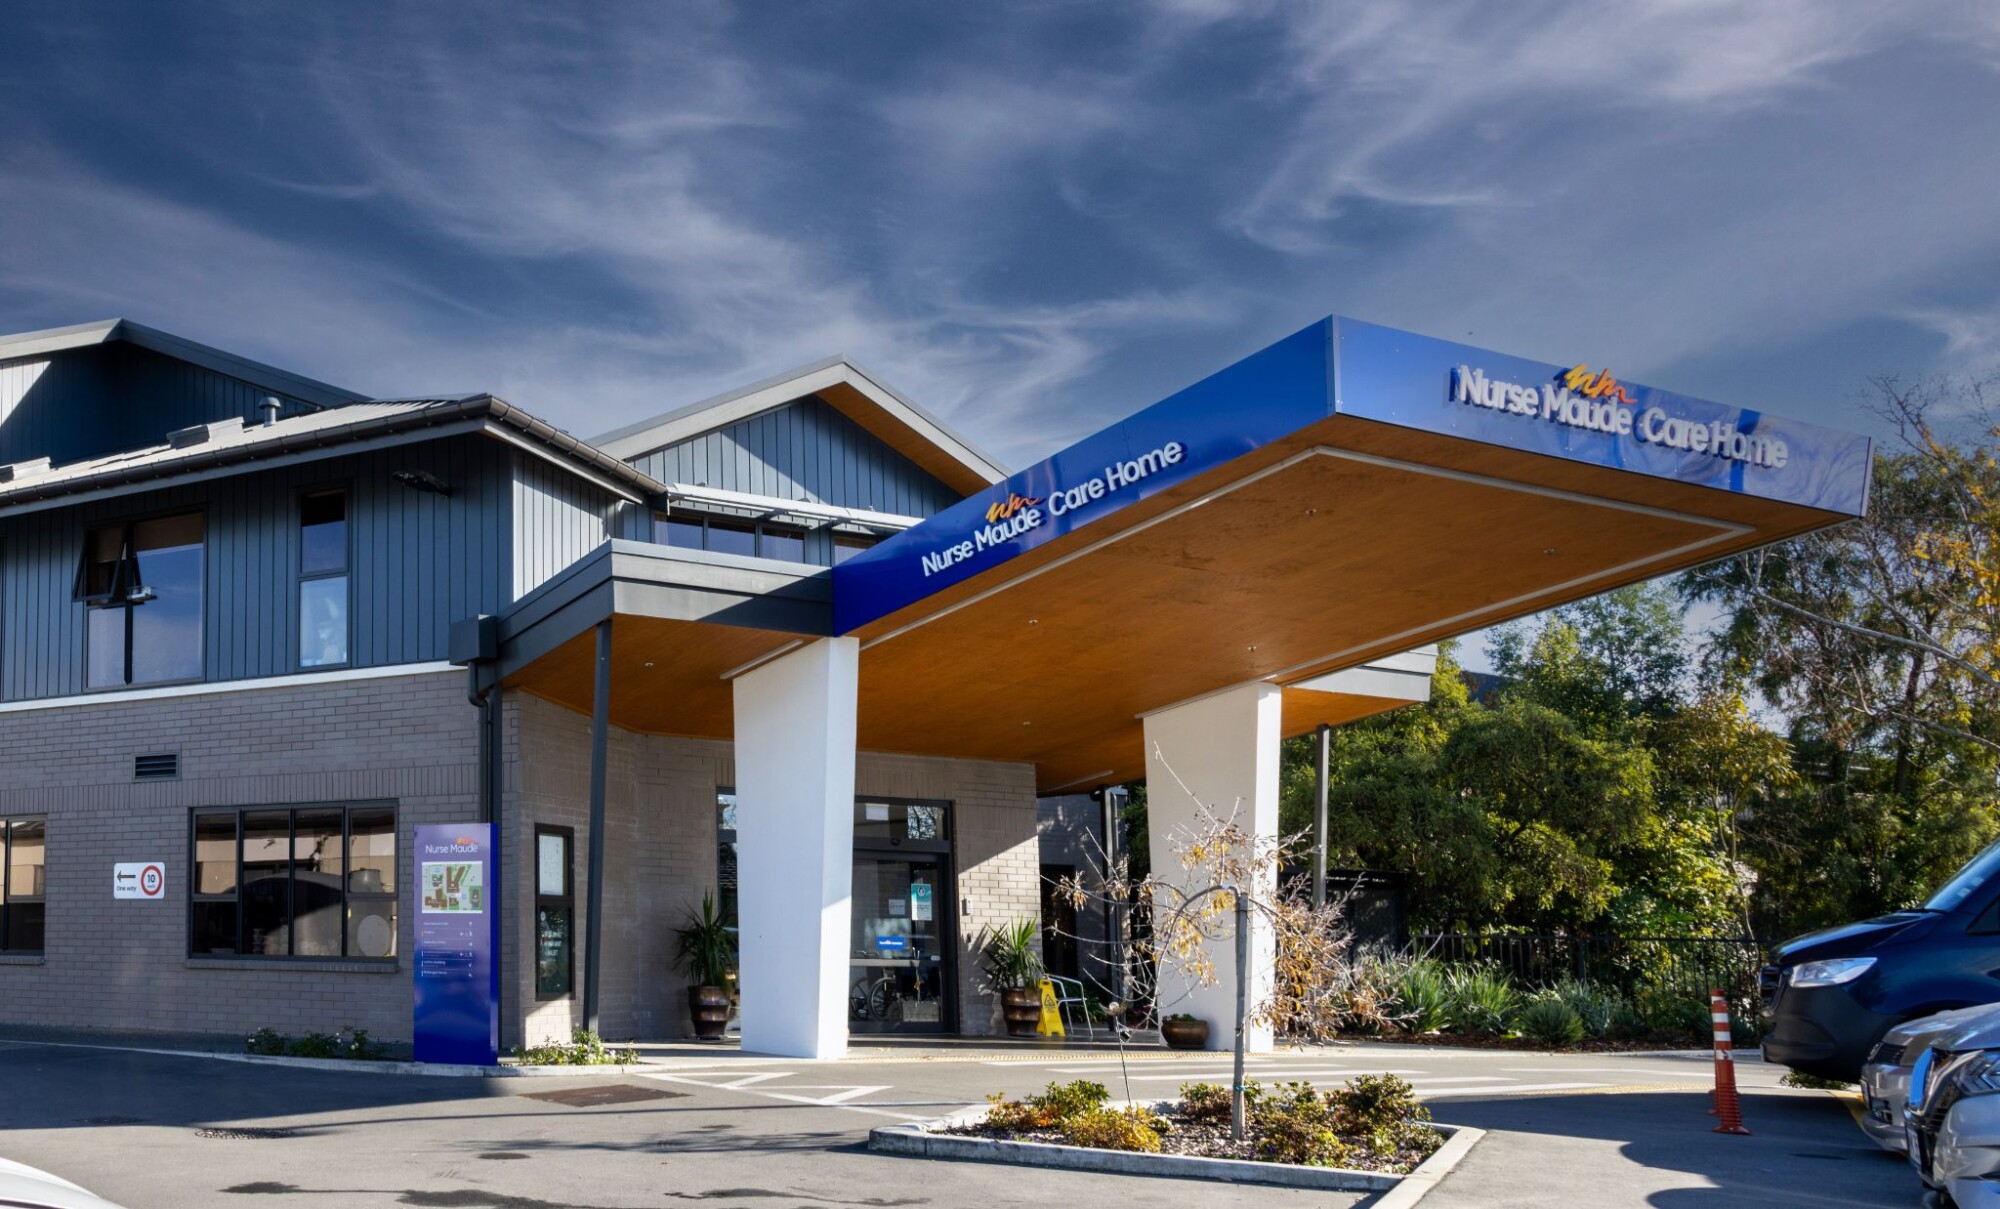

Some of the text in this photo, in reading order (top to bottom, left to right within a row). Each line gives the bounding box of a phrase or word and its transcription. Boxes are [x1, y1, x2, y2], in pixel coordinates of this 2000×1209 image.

[1459, 364, 1788, 468] Nurse Maude Care Home
[921, 441, 1183, 577] Nurse Maude Care Home
[425, 843, 478, 854] Nurse Maude
[147, 874, 155, 883] 10
